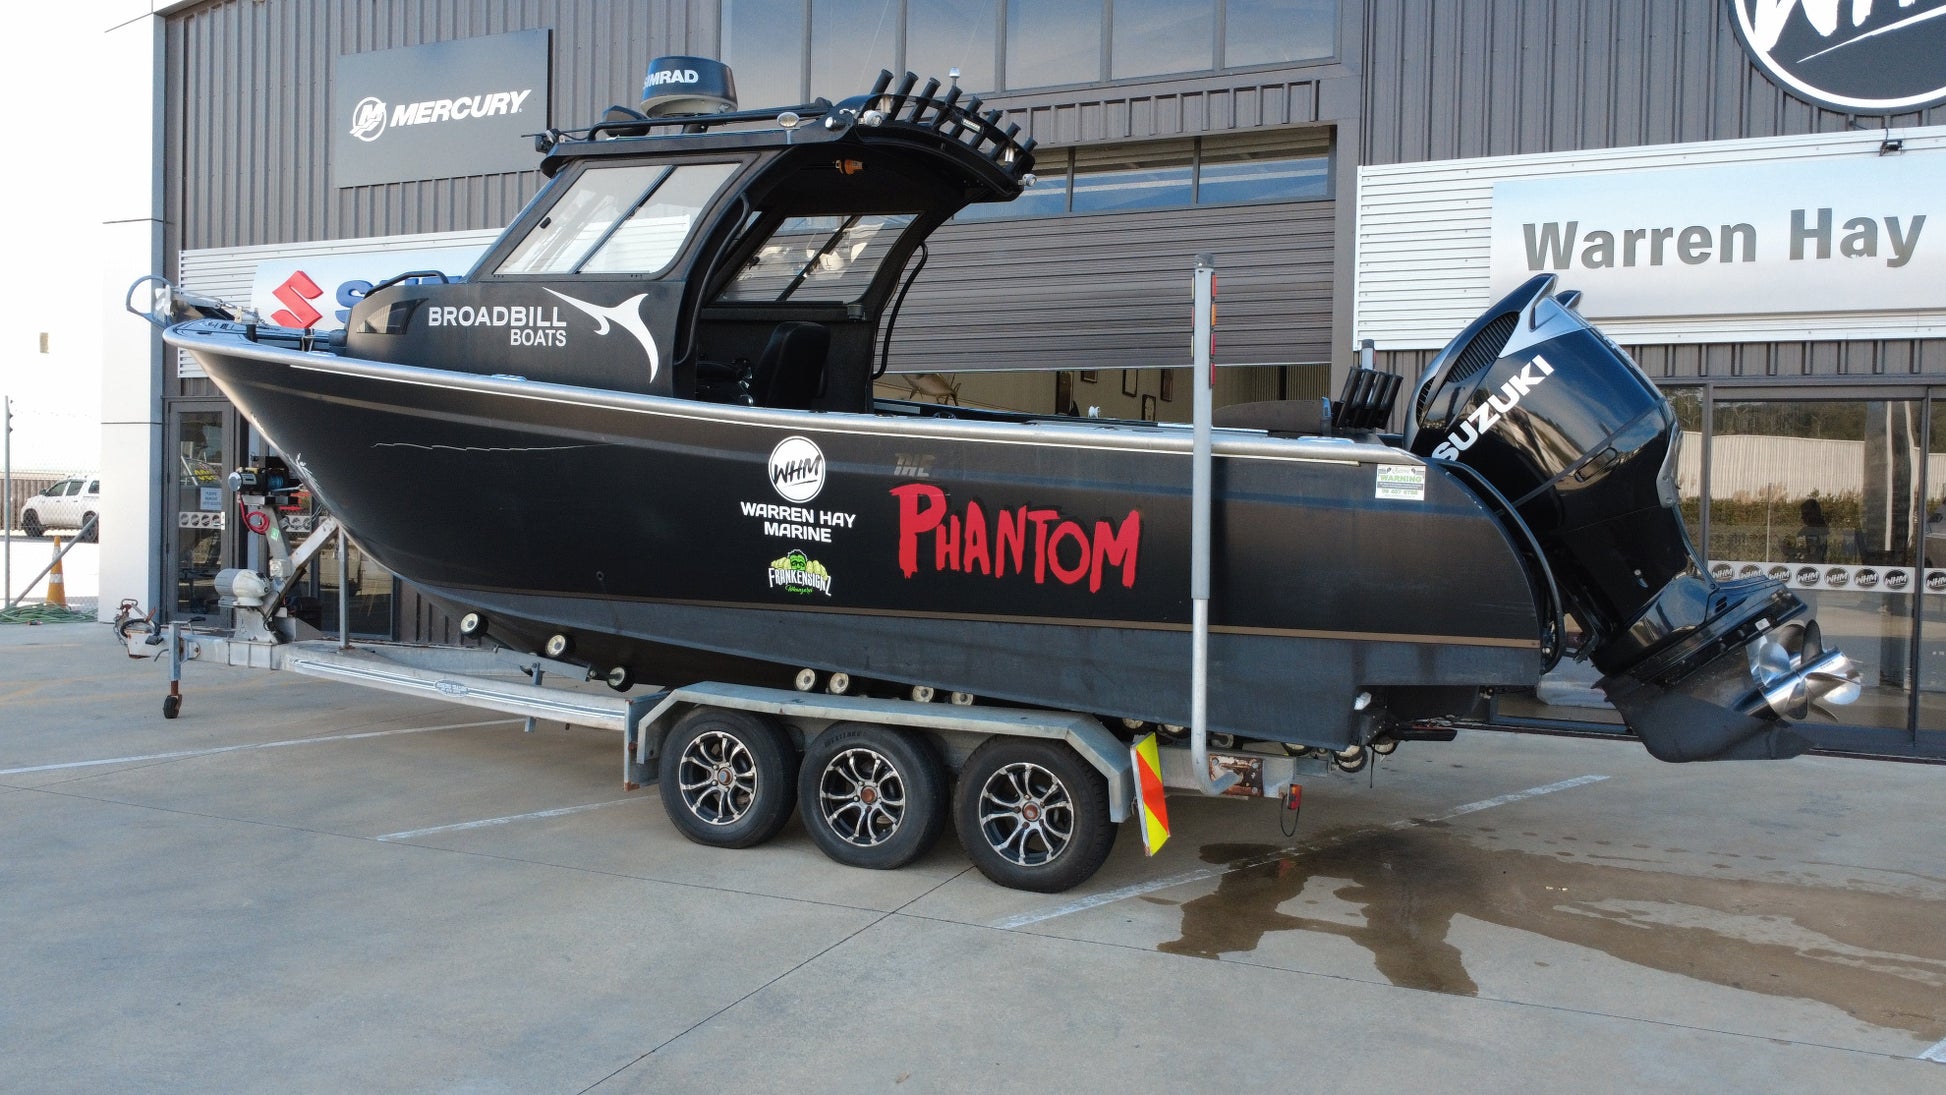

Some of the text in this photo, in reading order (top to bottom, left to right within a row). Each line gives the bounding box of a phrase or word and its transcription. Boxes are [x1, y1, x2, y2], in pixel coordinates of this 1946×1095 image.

[389, 89, 532, 128] MERCURY
[1522, 207, 1927, 271] Warren Hay
[428, 306, 567, 327] BROADBILL
[510, 328, 567, 347] BOATS
[1431, 354, 1555, 462] SUZUKI
[773, 453, 822, 485] WHM
[1380, 475, 1422, 483] WARNING
[740, 501, 857, 529] WARREN HAY
[764, 521, 832, 543] MARINE
[1797, 571, 1819, 582] WHM
[1826, 572, 1848, 583] WHM
[1856, 573, 1878, 585] WHM
[1885, 574, 1907, 586] WHM
